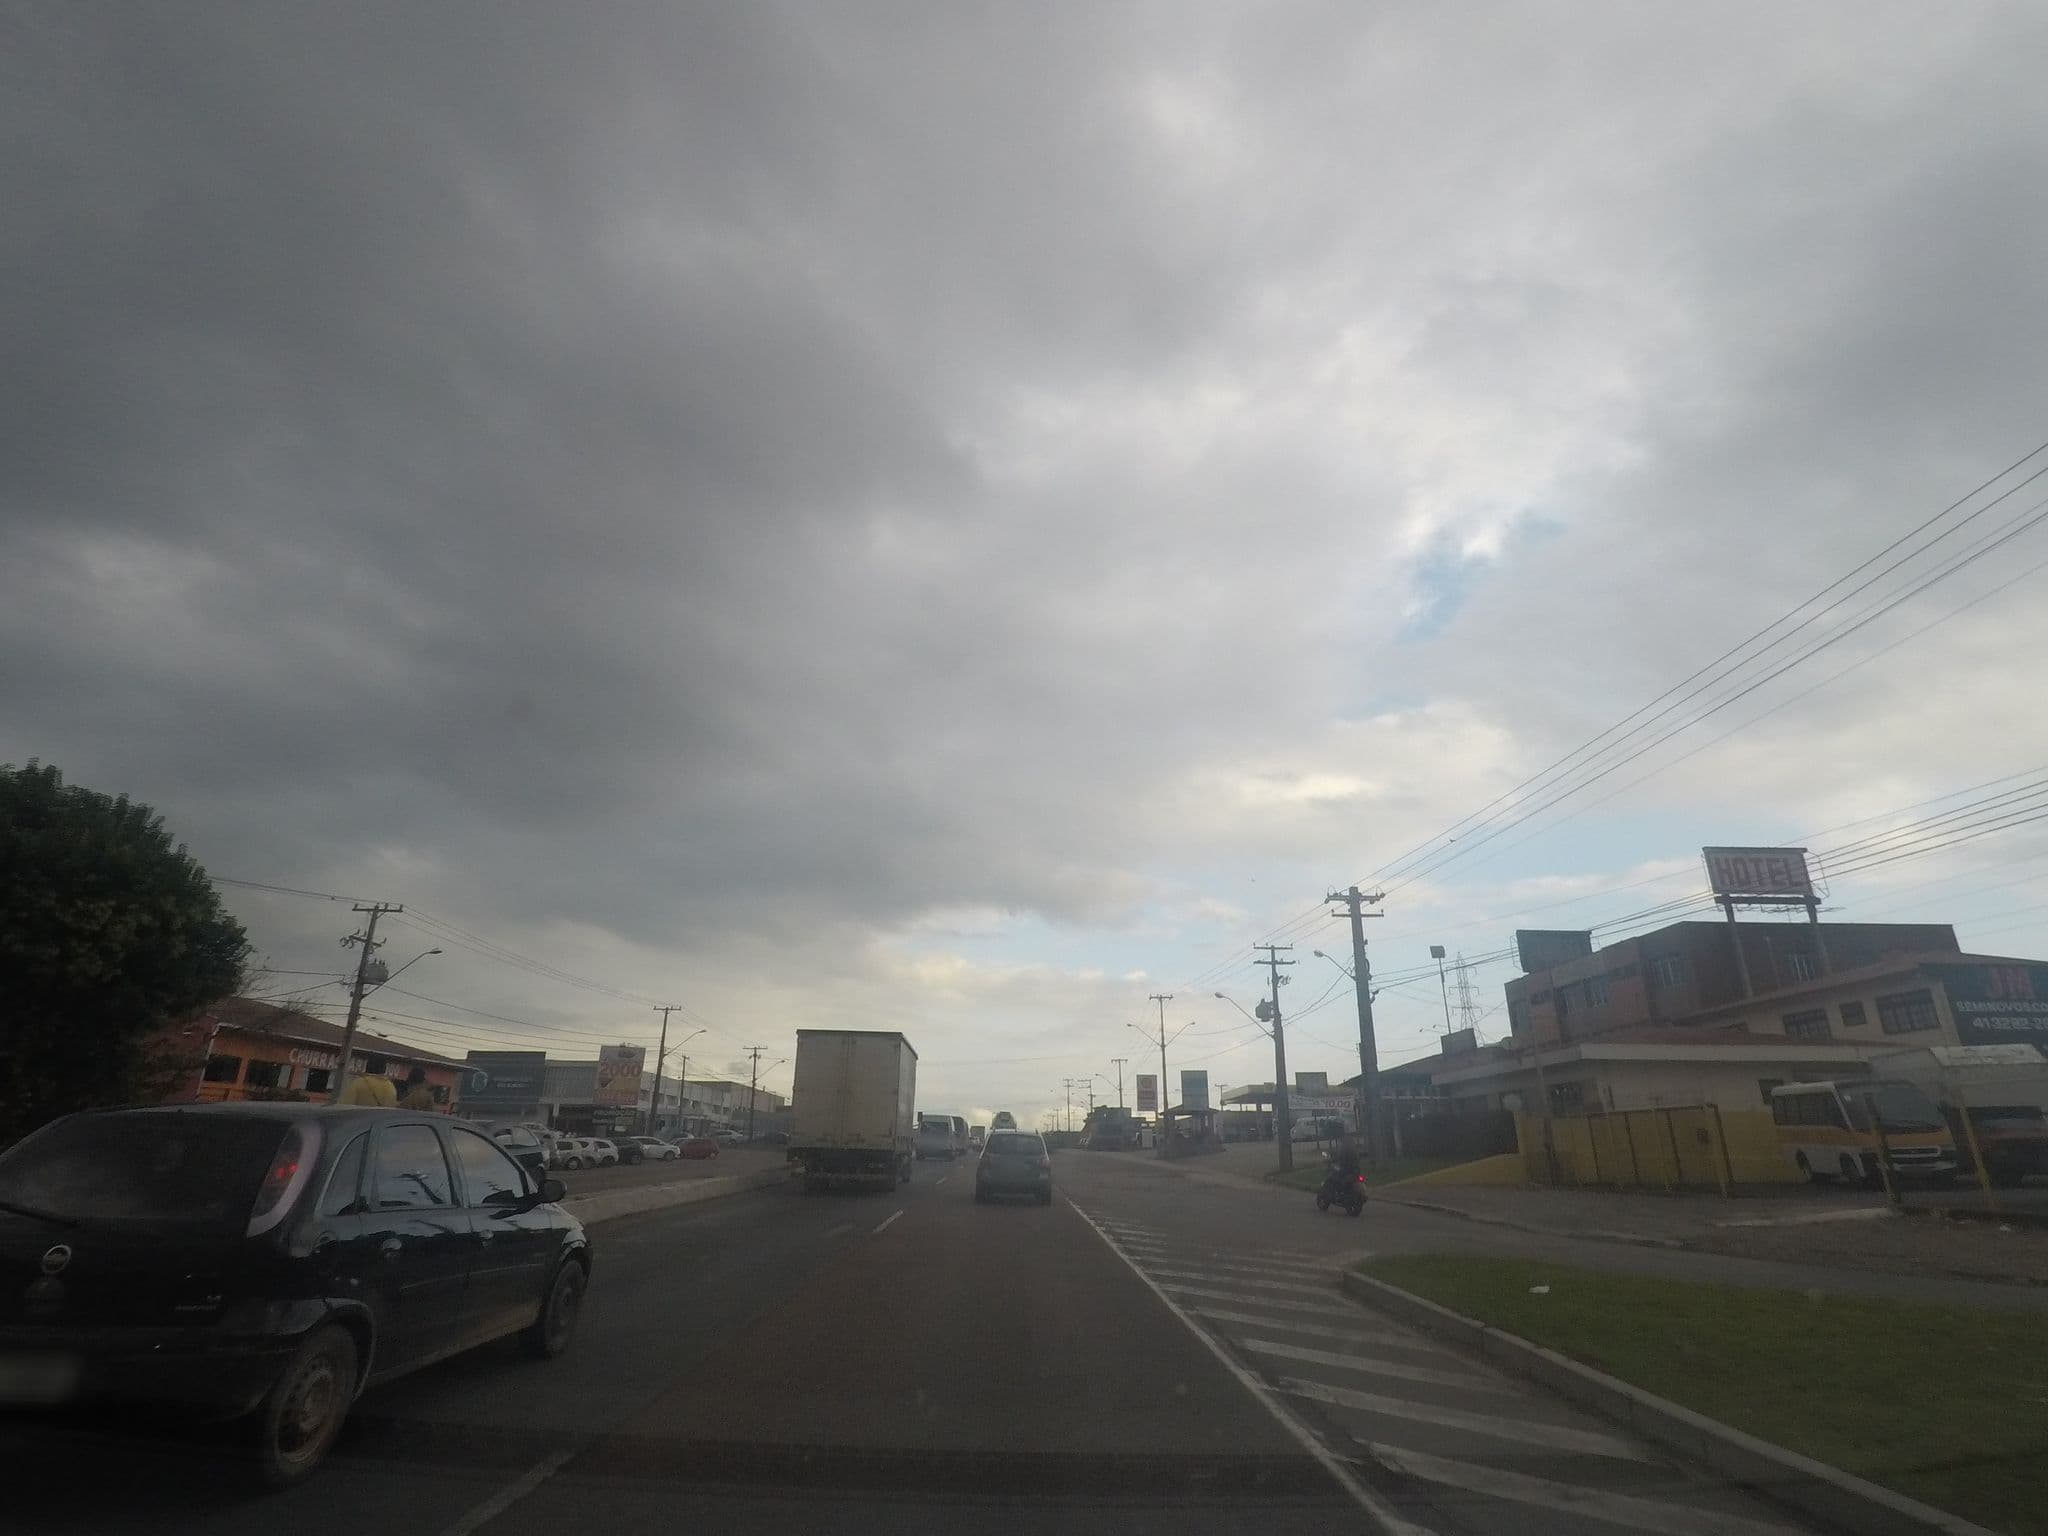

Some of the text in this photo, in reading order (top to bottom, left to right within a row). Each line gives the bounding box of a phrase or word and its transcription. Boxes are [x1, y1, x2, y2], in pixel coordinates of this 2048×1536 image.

[1714, 856, 1808, 887] HOTEL
[288, 1047, 369, 1073] CHURRAARI
[600, 1062, 641, 1078] 2000
